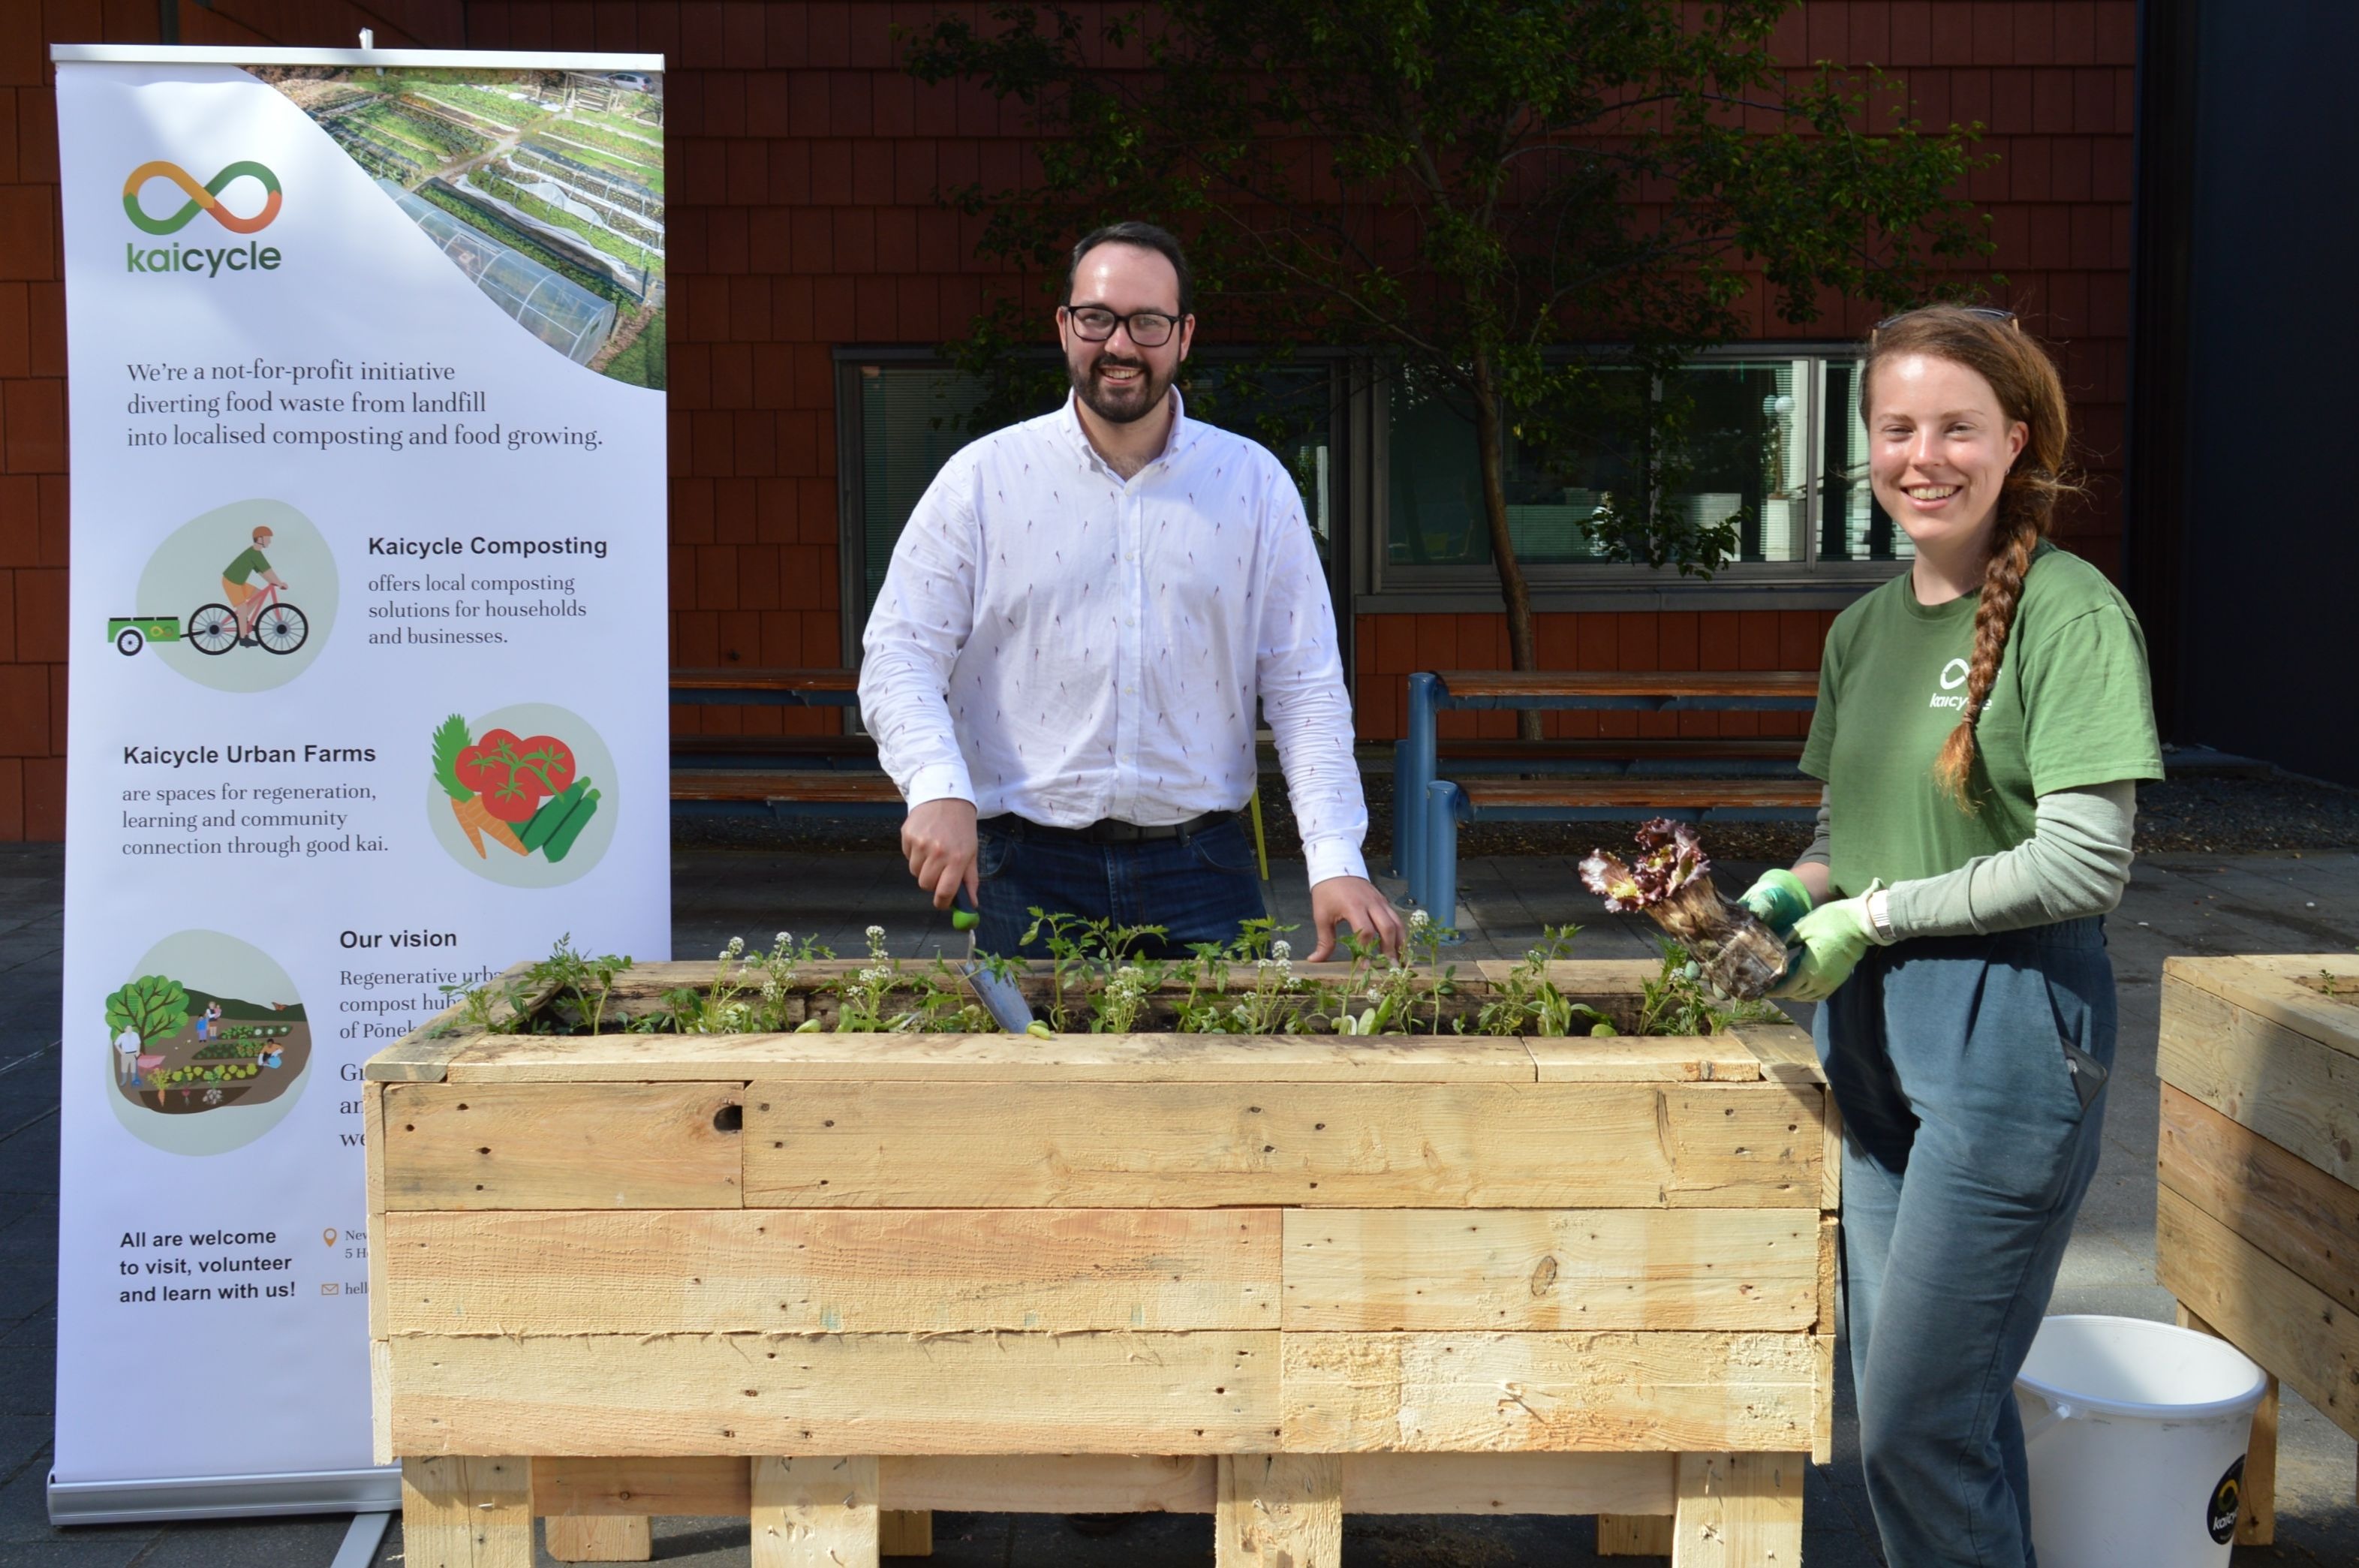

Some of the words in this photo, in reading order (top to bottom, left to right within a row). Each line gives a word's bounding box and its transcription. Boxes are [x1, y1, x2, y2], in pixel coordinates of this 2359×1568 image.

[127, 241, 281, 278] kaicycle
[194, 367, 205, 380] a
[212, 358, 354, 385] not-for-profit
[361, 362, 455, 381] initiative
[128, 393, 221, 418] diverting
[226, 390, 273, 411] food
[278, 397, 345, 411] waste
[352, 391, 405, 413] from
[412, 391, 486, 412] landfill
[128, 428, 167, 446] into
[174, 423, 266, 444] localised
[273, 426, 403, 451] composting
[409, 423, 447, 444] and
[455, 423, 501, 444] food
[507, 426, 603, 451] growing.
[369, 537, 463, 559] Kaicycle
[471, 537, 606, 558] Composting
[369, 574, 420, 591] offers
[426, 573, 465, 591] local
[471, 575, 575, 595] composting
[369, 600, 450, 618] solutions
[456, 600, 480, 617] for
[486, 599, 586, 616] households
[369, 627, 402, 644] and
[408, 627, 507, 644] businesses.
[1930, 693, 1993, 711] kaicye
[124, 745, 218, 769] Kaicycle
[227, 745, 295, 763] Urban
[305, 745, 376, 762] Farms
[122, 790, 151, 801] are
[156, 790, 216, 805] spaces
[221, 783, 248, 799] for
[253, 784, 376, 805] regeneration,
[123, 811, 197, 832] learning
[202, 809, 236, 826] and
[241, 810, 348, 830] community
[122, 838, 221, 854] connection
[227, 835, 300, 858] through
[306, 835, 350, 857] good
[357, 835, 388, 851] kai.
[340, 931, 383, 949] Our
[389, 929, 456, 947] vision
[340, 968, 456, 990] Regenerative
[340, 998, 417, 1016] compost
[423, 993, 462, 1010] hub
[340, 1021, 360, 1039] of
[120, 1232, 146, 1247] All
[152, 1235, 183, 1247] are
[189, 1229, 276, 1246] welcome
[345, 1248, 353, 1259] 5
[357, 1247, 369, 1258] H
[119, 1260, 139, 1275] to
[145, 1258, 191, 1276] visit,
[198, 1257, 292, 1273] volunteer
[119, 1286, 156, 1302] and
[163, 1286, 211, 1302] learn
[218, 1283, 258, 1299] with
[266, 1281, 295, 1298] us!
